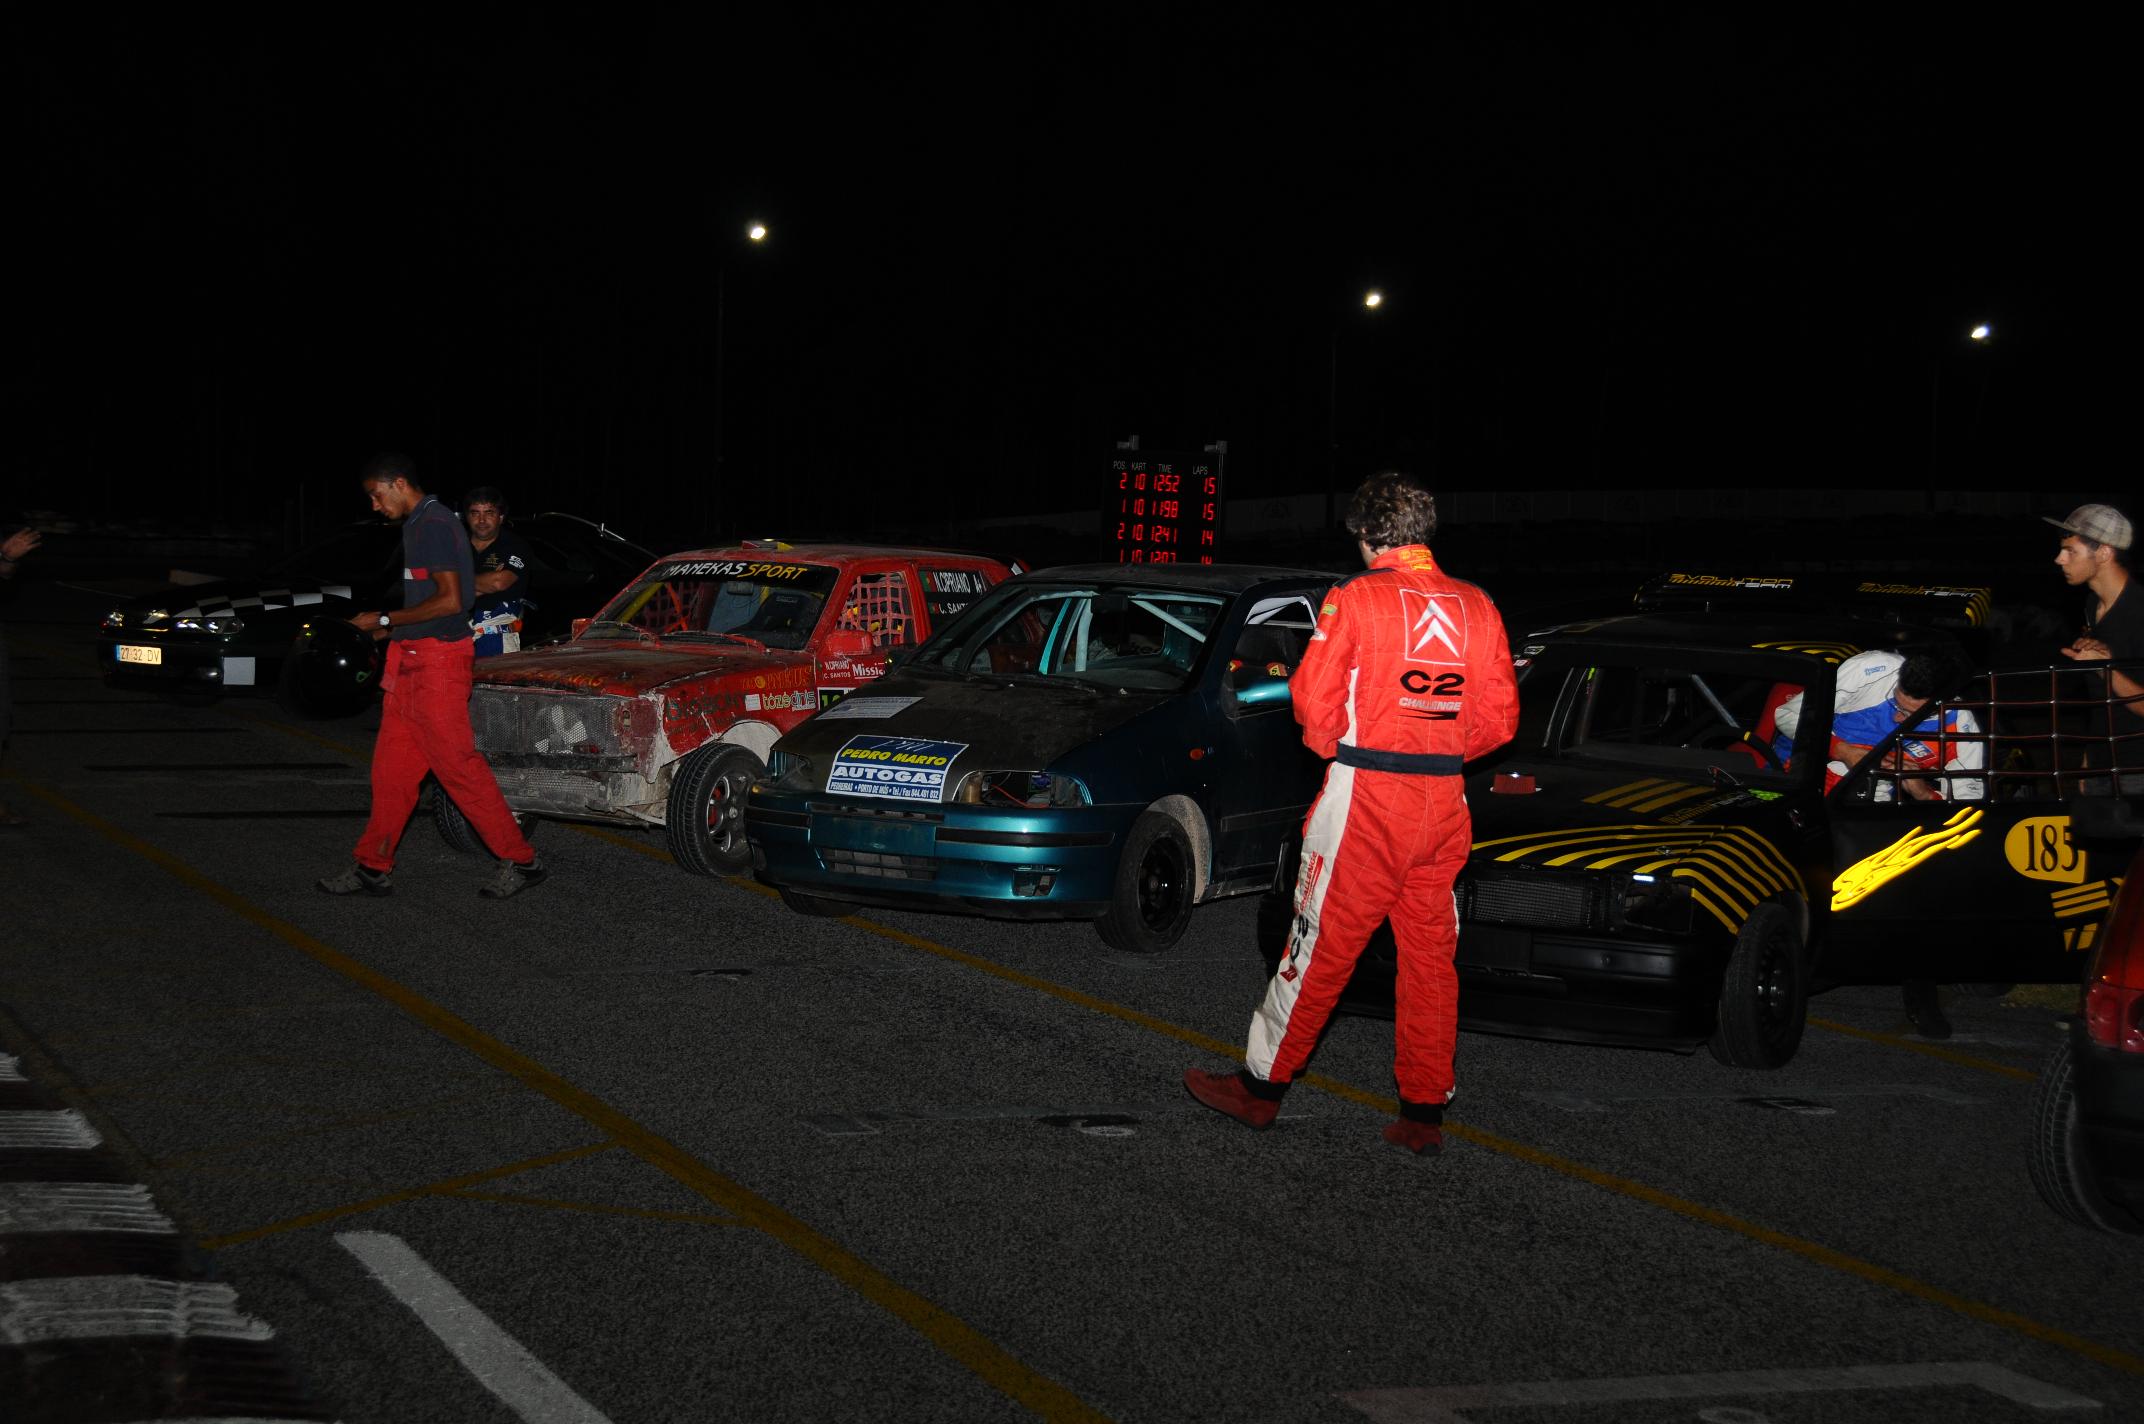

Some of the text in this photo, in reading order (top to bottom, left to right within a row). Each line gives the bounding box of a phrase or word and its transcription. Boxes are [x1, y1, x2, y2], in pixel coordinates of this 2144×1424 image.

[1131, 462, 1147, 471] KART
[1158, 464, 1172, 473] TIME
[1192, 465, 1208, 475] LAPS
[1119, 472, 1216, 494] 2 10 1252 15
[1121, 498, 1215, 520] 1 10 1198 15
[1117, 522, 1214, 546] 2 10 1241 14
[1399, 669, 1465, 696] C2
[1398, 696, 1463, 711] CHALLENGE
[841, 748, 948, 766] PEDRO MARTO
[832, 766, 942, 785] AUTOGAS
[2025, 825, 2079, 872] 185
